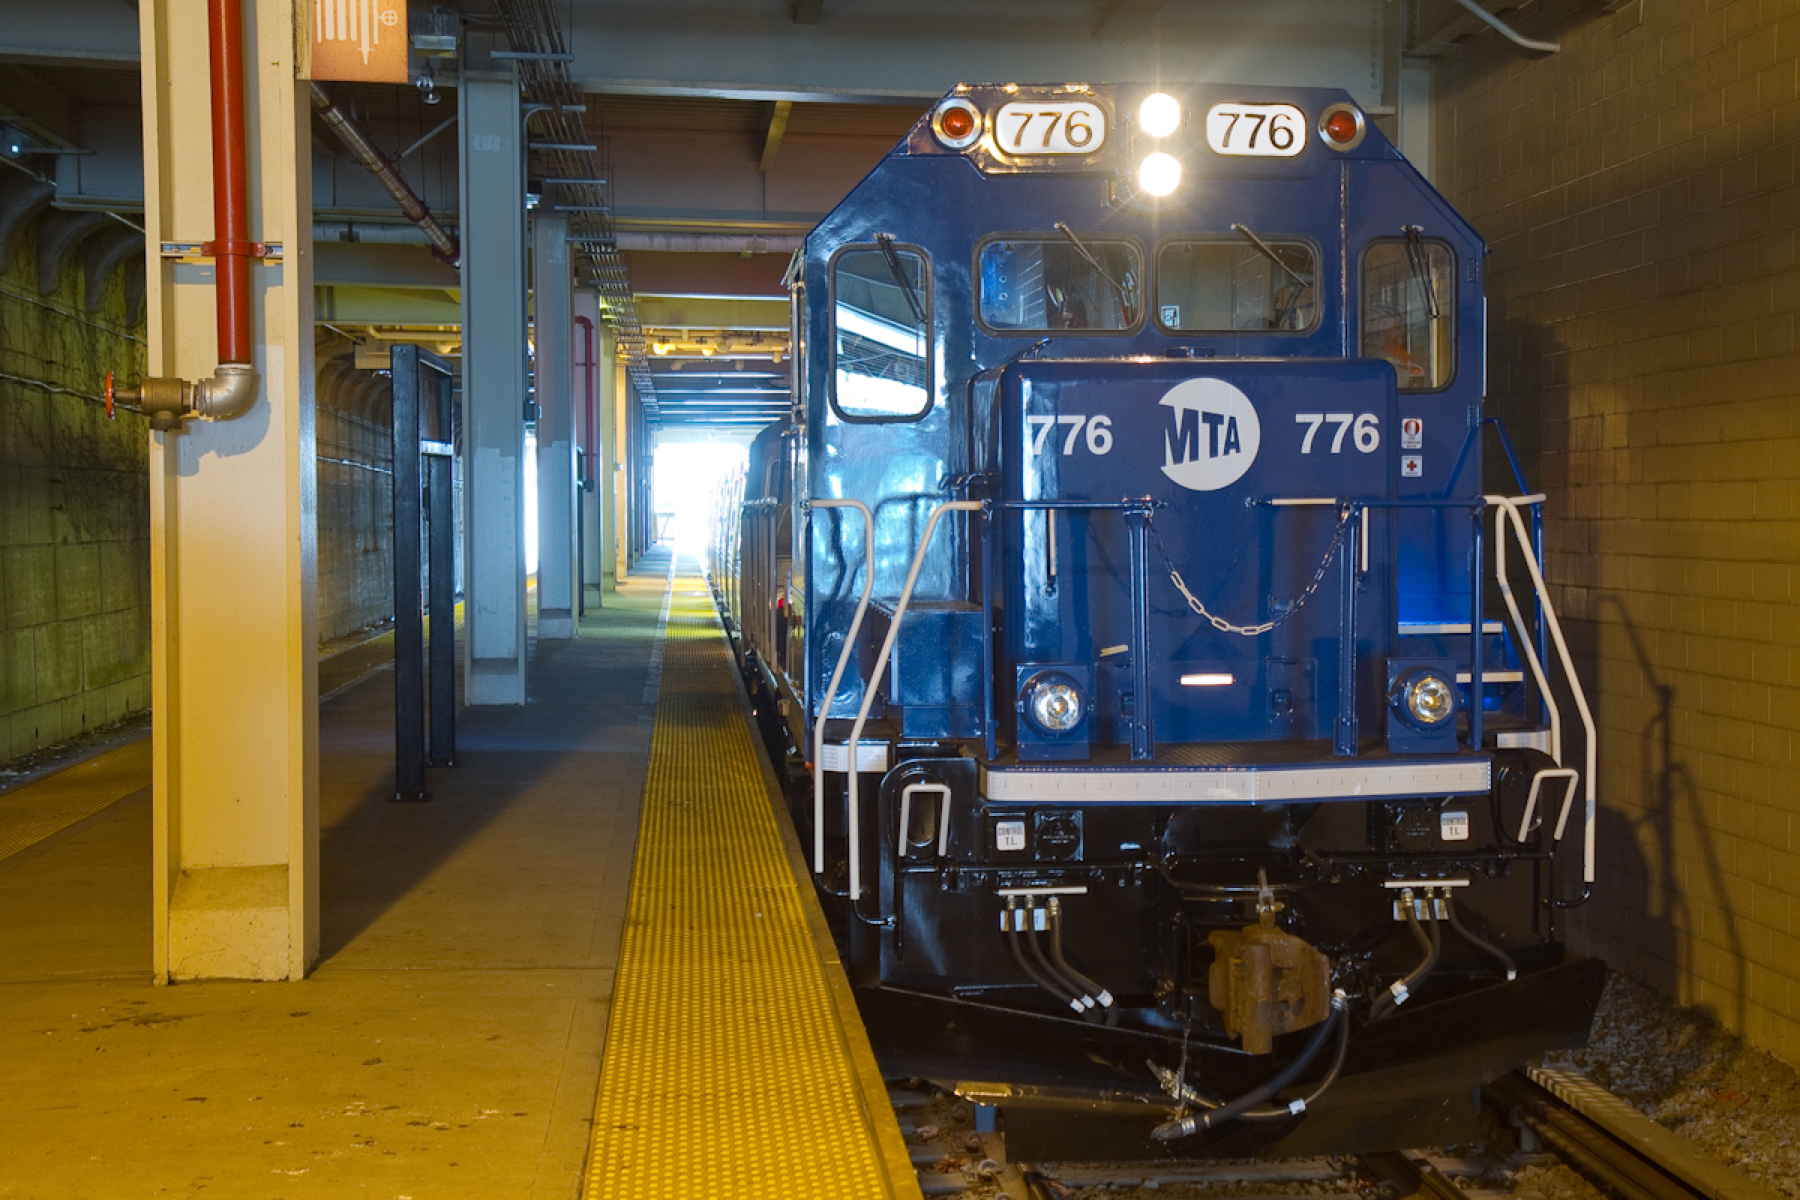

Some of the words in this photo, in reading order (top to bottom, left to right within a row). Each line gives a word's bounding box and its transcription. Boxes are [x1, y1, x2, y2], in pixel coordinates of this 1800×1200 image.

[1010, 111, 1094, 147] 776
[1217, 112, 1294, 150] 776
[1026, 415, 1113, 456] 776
[1163, 405, 1241, 466] MTA
[1295, 413, 1381, 454] 776
